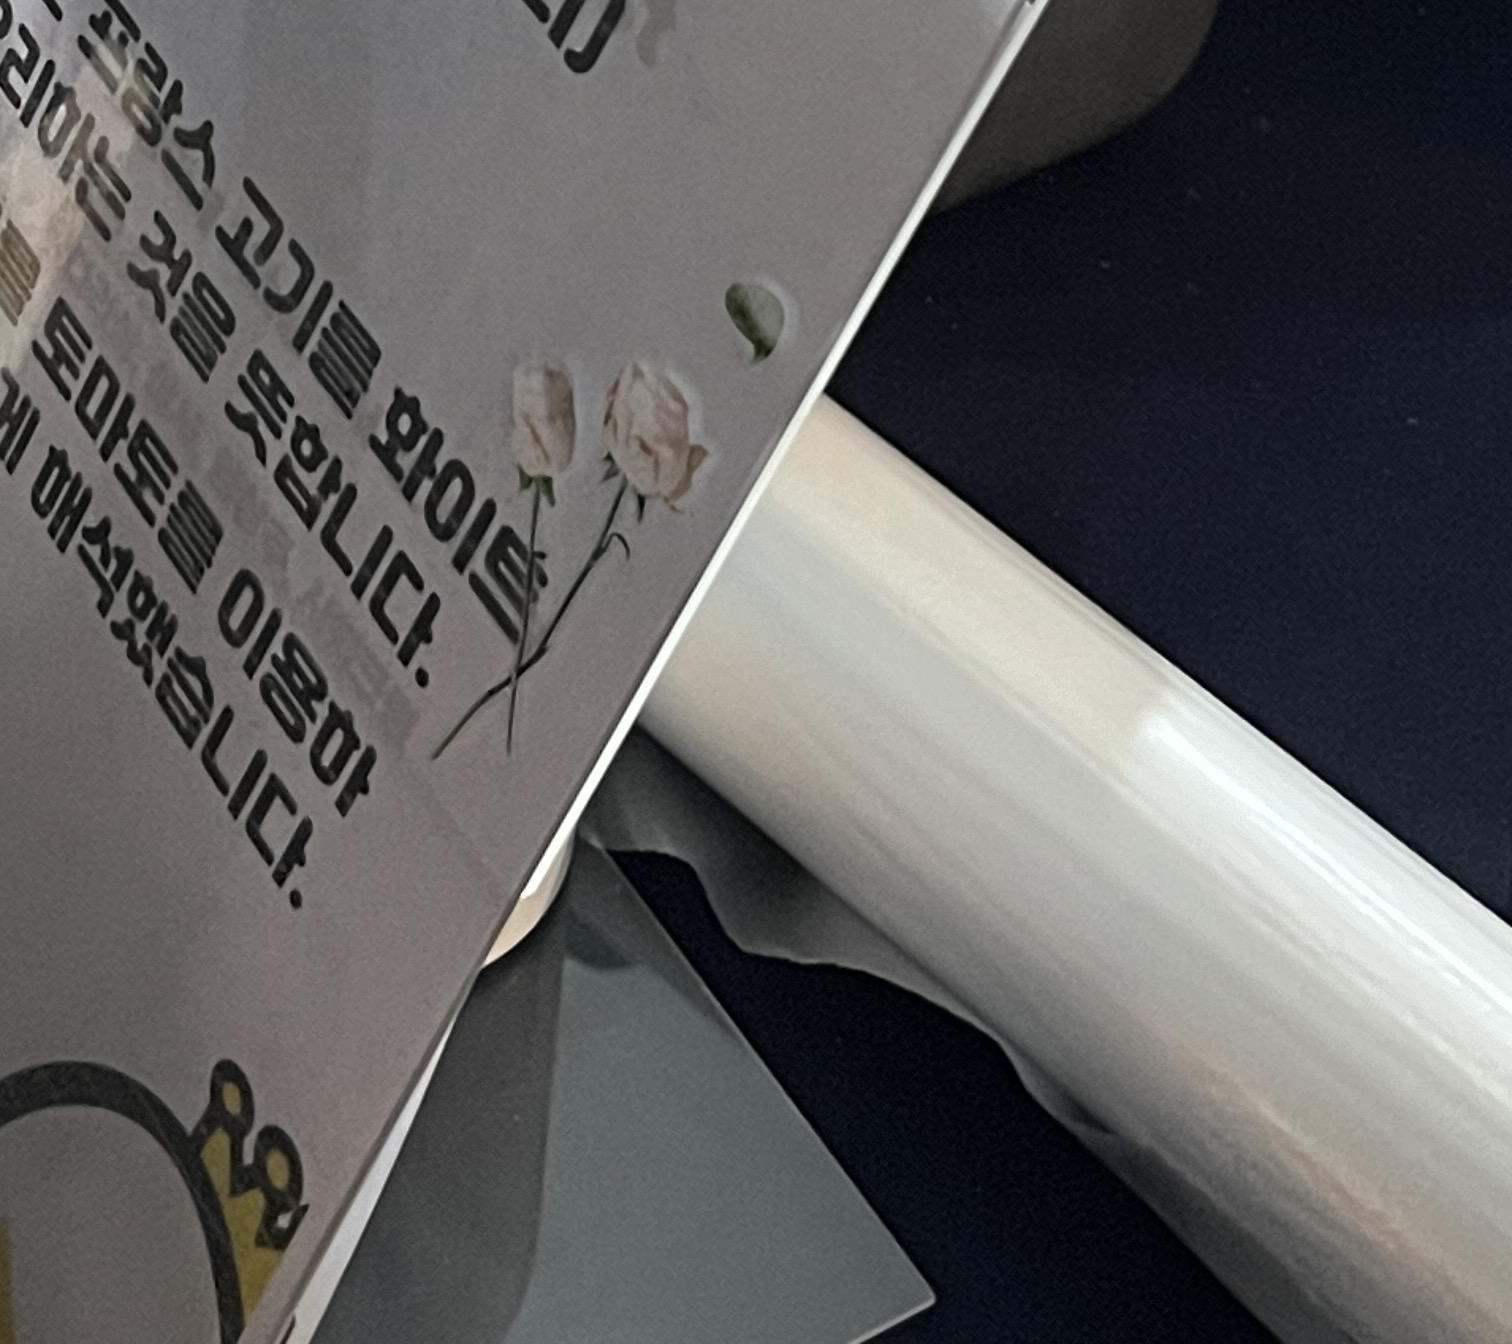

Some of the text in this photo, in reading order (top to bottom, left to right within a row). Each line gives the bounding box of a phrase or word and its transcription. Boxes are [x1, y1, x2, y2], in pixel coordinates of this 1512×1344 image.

[30, 295, 224, 595] 토마토를
[216, 567, 377, 819] 이용하
[125, 209, 236, 384] 것을
[223, 348, 441, 689] 뜻합니다.
[214, 175, 382, 421] 고기를
[367, 385, 549, 646] 화이트
[29, 443, 313, 911] 해석했습니다.
